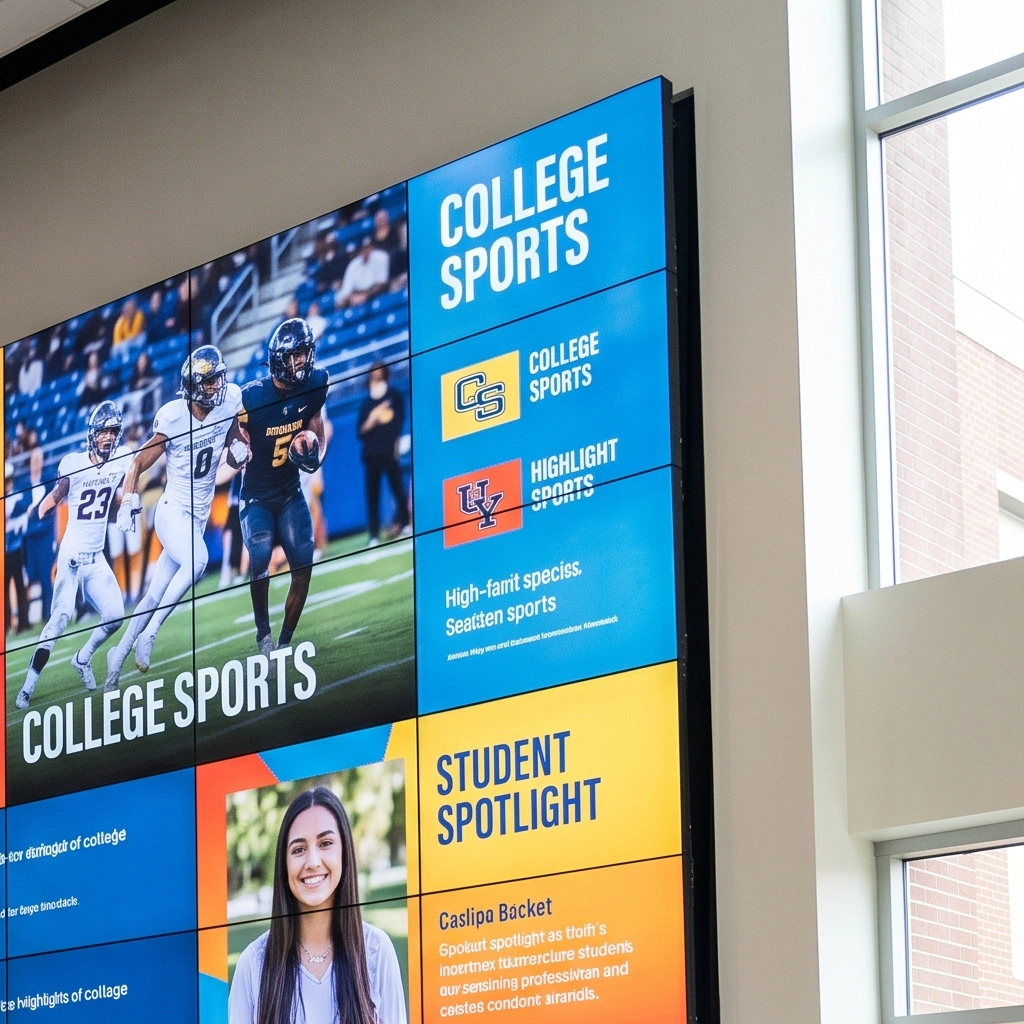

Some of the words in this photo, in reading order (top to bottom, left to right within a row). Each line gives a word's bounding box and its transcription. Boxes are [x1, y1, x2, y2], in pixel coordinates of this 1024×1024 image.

[440, 133, 610, 249] COLLEGE
[440, 207, 590, 310] SPORTS
[529, 331, 600, 375] COLLEGE
[529, 363, 593, 403] SPORTS
[271, 434, 292, 468] 5
[531, 437, 619, 484] HIGHLIGHT
[77, 486, 112, 520] 23
[531, 473, 595, 512] SPORTS
[507, 595, 557, 625] sports
[22, 678, 166, 765] COLLEGE
[173, 641, 318, 729] SPORTS
[436, 730, 571, 796] STUDENT
[437, 777, 602, 846] SPOTLIGHT
[69, 835, 82, 852] of
[489, 929, 546, 952] spotlight
[547, 929, 563, 942] as
[603, 960, 629, 978] and
[71, 988, 83, 1002] of
